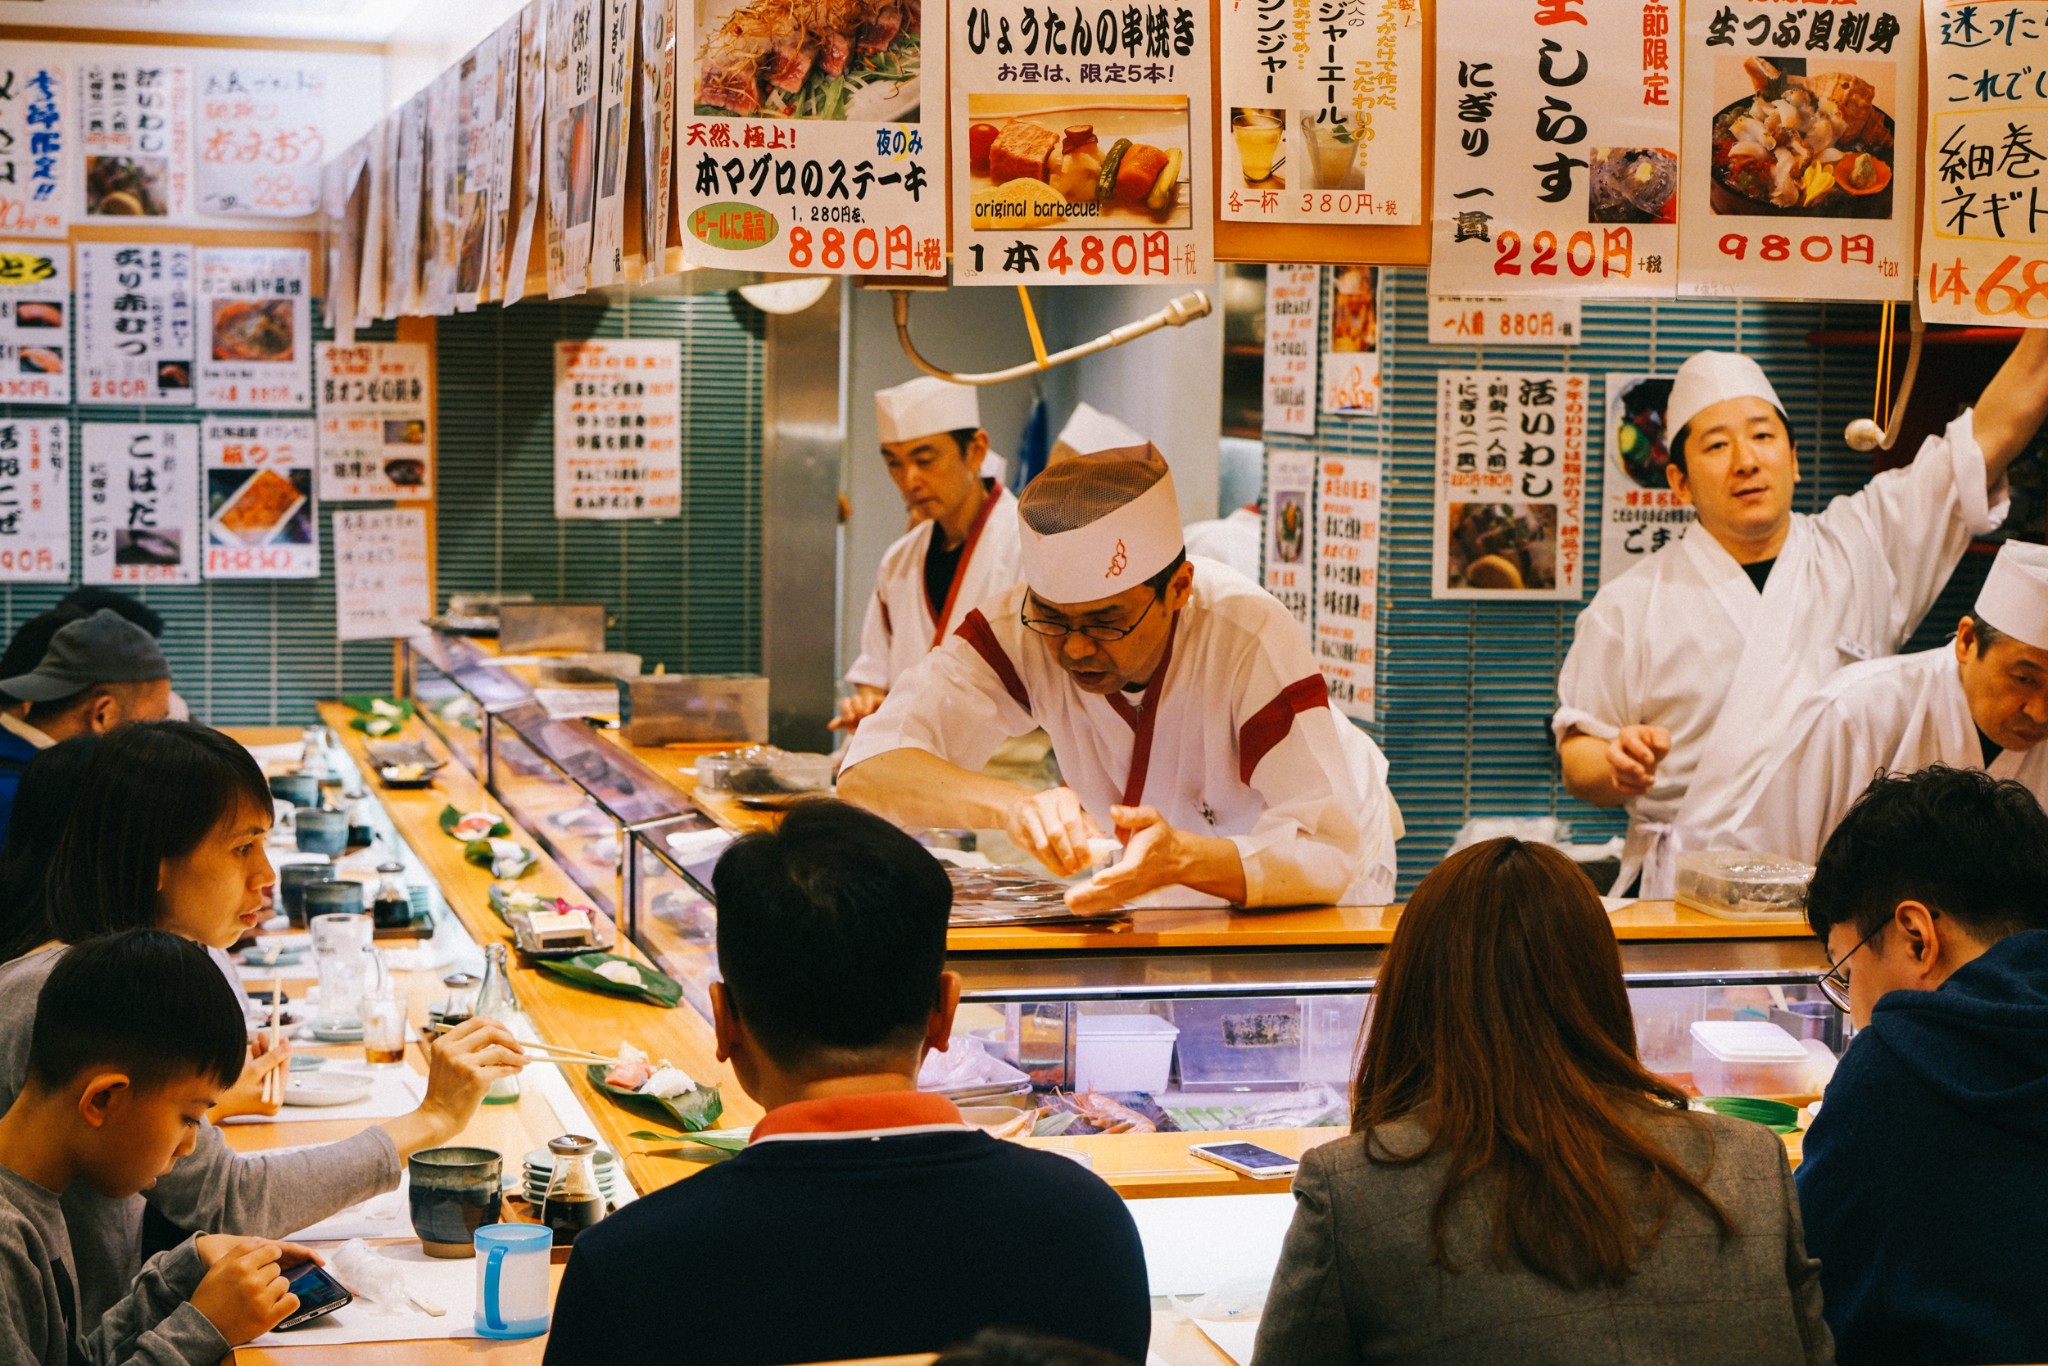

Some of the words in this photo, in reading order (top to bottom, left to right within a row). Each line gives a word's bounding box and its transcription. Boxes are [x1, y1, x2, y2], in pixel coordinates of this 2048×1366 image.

[967, 4, 1195, 58] ひょうたんの串焼き
[1706, 5, 1900, 54] 生つぶ貝刺身
[1941, 7, 2048, 47] 迷った
[1643, 0, 1669, 106] 節限定
[997, 63, 1175, 84] お昼は、限定5本!
[1458, 60, 1497, 157] にぎり
[686, 122, 797, 149] 天然、極上!
[876, 127, 923, 156] 夜のみ
[694, 151, 928, 203] 本マグロのステーキ
[975, 199, 1027, 219] original
[1033, 200, 1100, 217] barbecue!
[1228, 190, 1279, 214] 各一杯
[695, 210, 775, 242] ビールに最高!
[1718, 233, 1875, 265] 980円
[1518, 377, 1557, 498] 活いわし
[129, 434, 157, 527] こはだ
[1624, 524, 1687, 554] ごま
